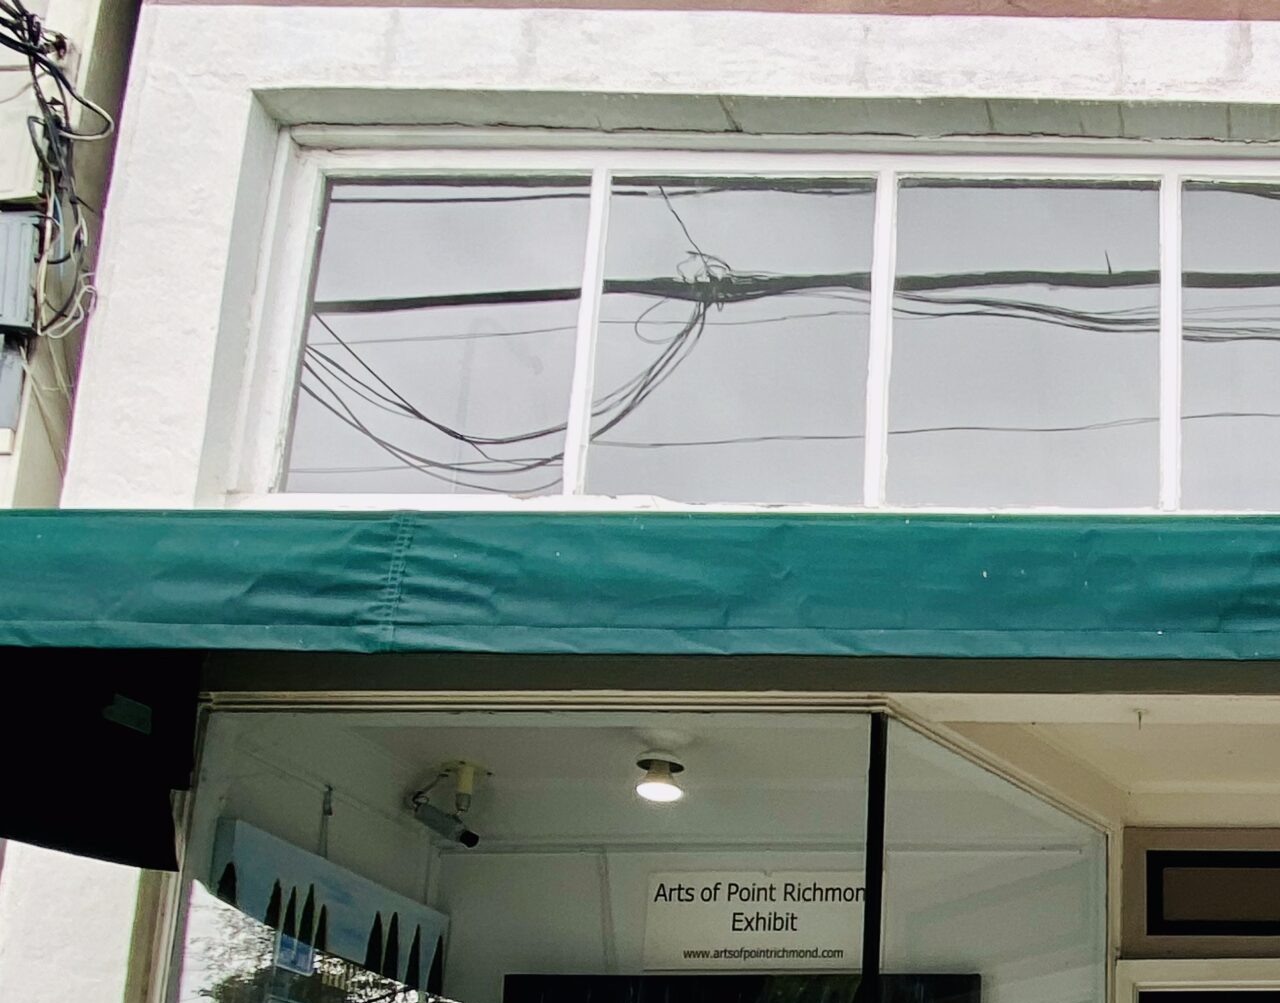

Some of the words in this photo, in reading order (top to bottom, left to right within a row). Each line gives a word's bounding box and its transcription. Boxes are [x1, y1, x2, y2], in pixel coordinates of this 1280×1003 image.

[654, 883, 695, 902] Arts
[700, 882, 722, 902] of
[727, 883, 777, 902] Point
[783, 882, 866, 902] Richmon
[731, 912, 798, 931] Exhibit
[683, 948, 844, 961] www.artsofpointrichmond.com
